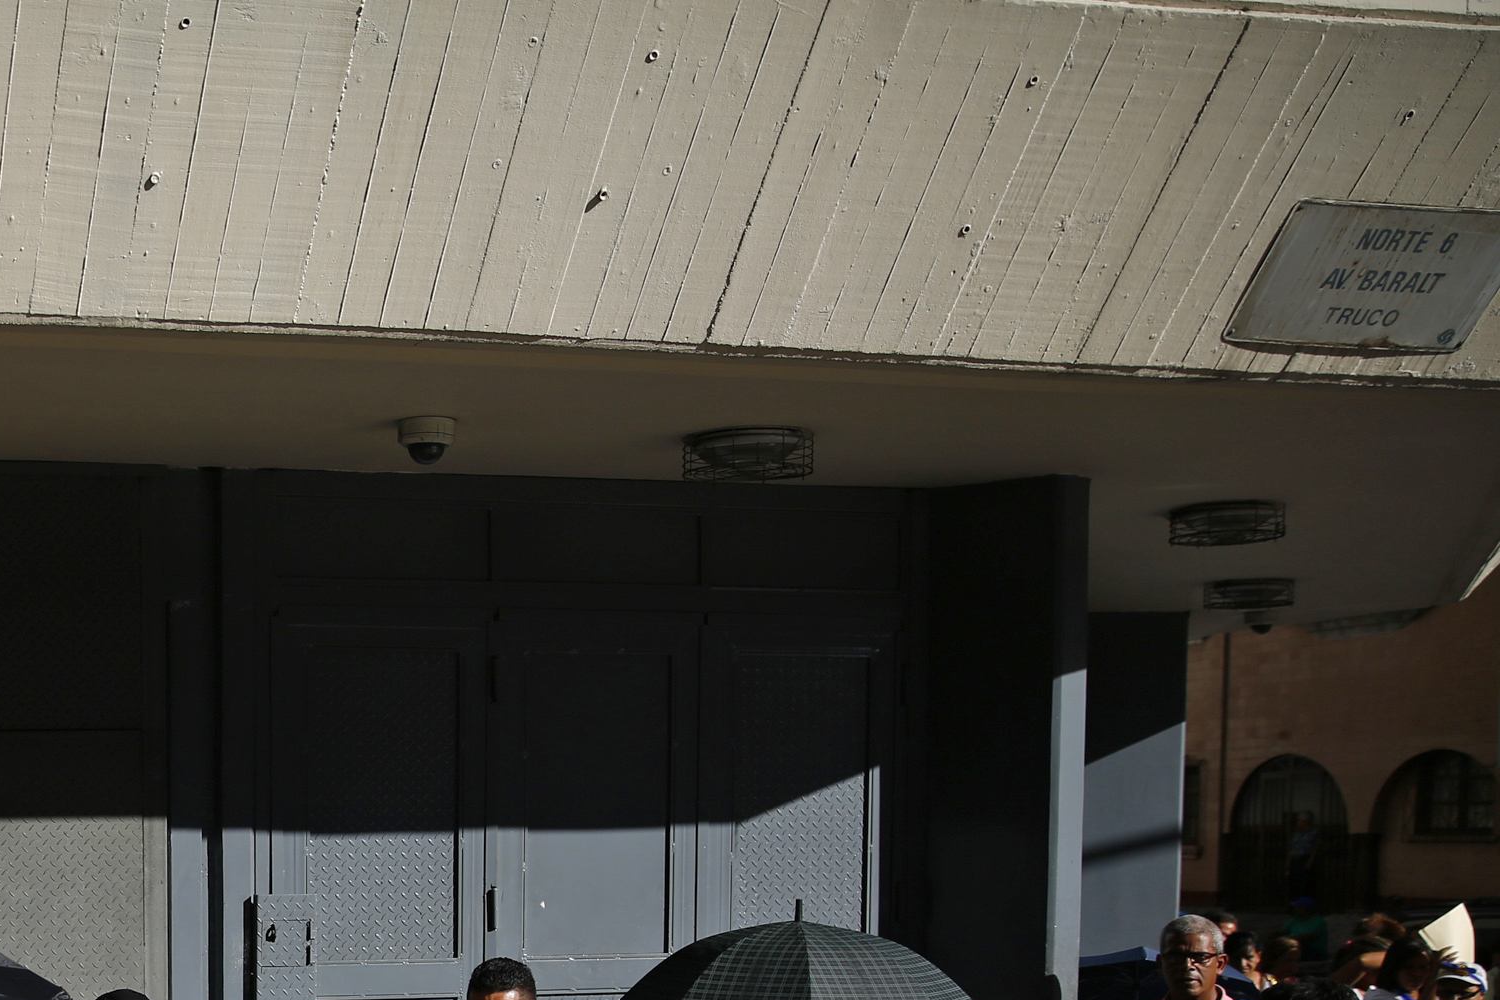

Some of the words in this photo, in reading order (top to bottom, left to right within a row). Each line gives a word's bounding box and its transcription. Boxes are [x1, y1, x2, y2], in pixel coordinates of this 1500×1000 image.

[1356, 228, 1433, 253] NORTE
[1439, 232, 1458, 254] 6
[1319, 268, 1354, 290] AV.
[1357, 269, 1447, 294] BARALT
[1325, 307, 1400, 327] TRUCO
